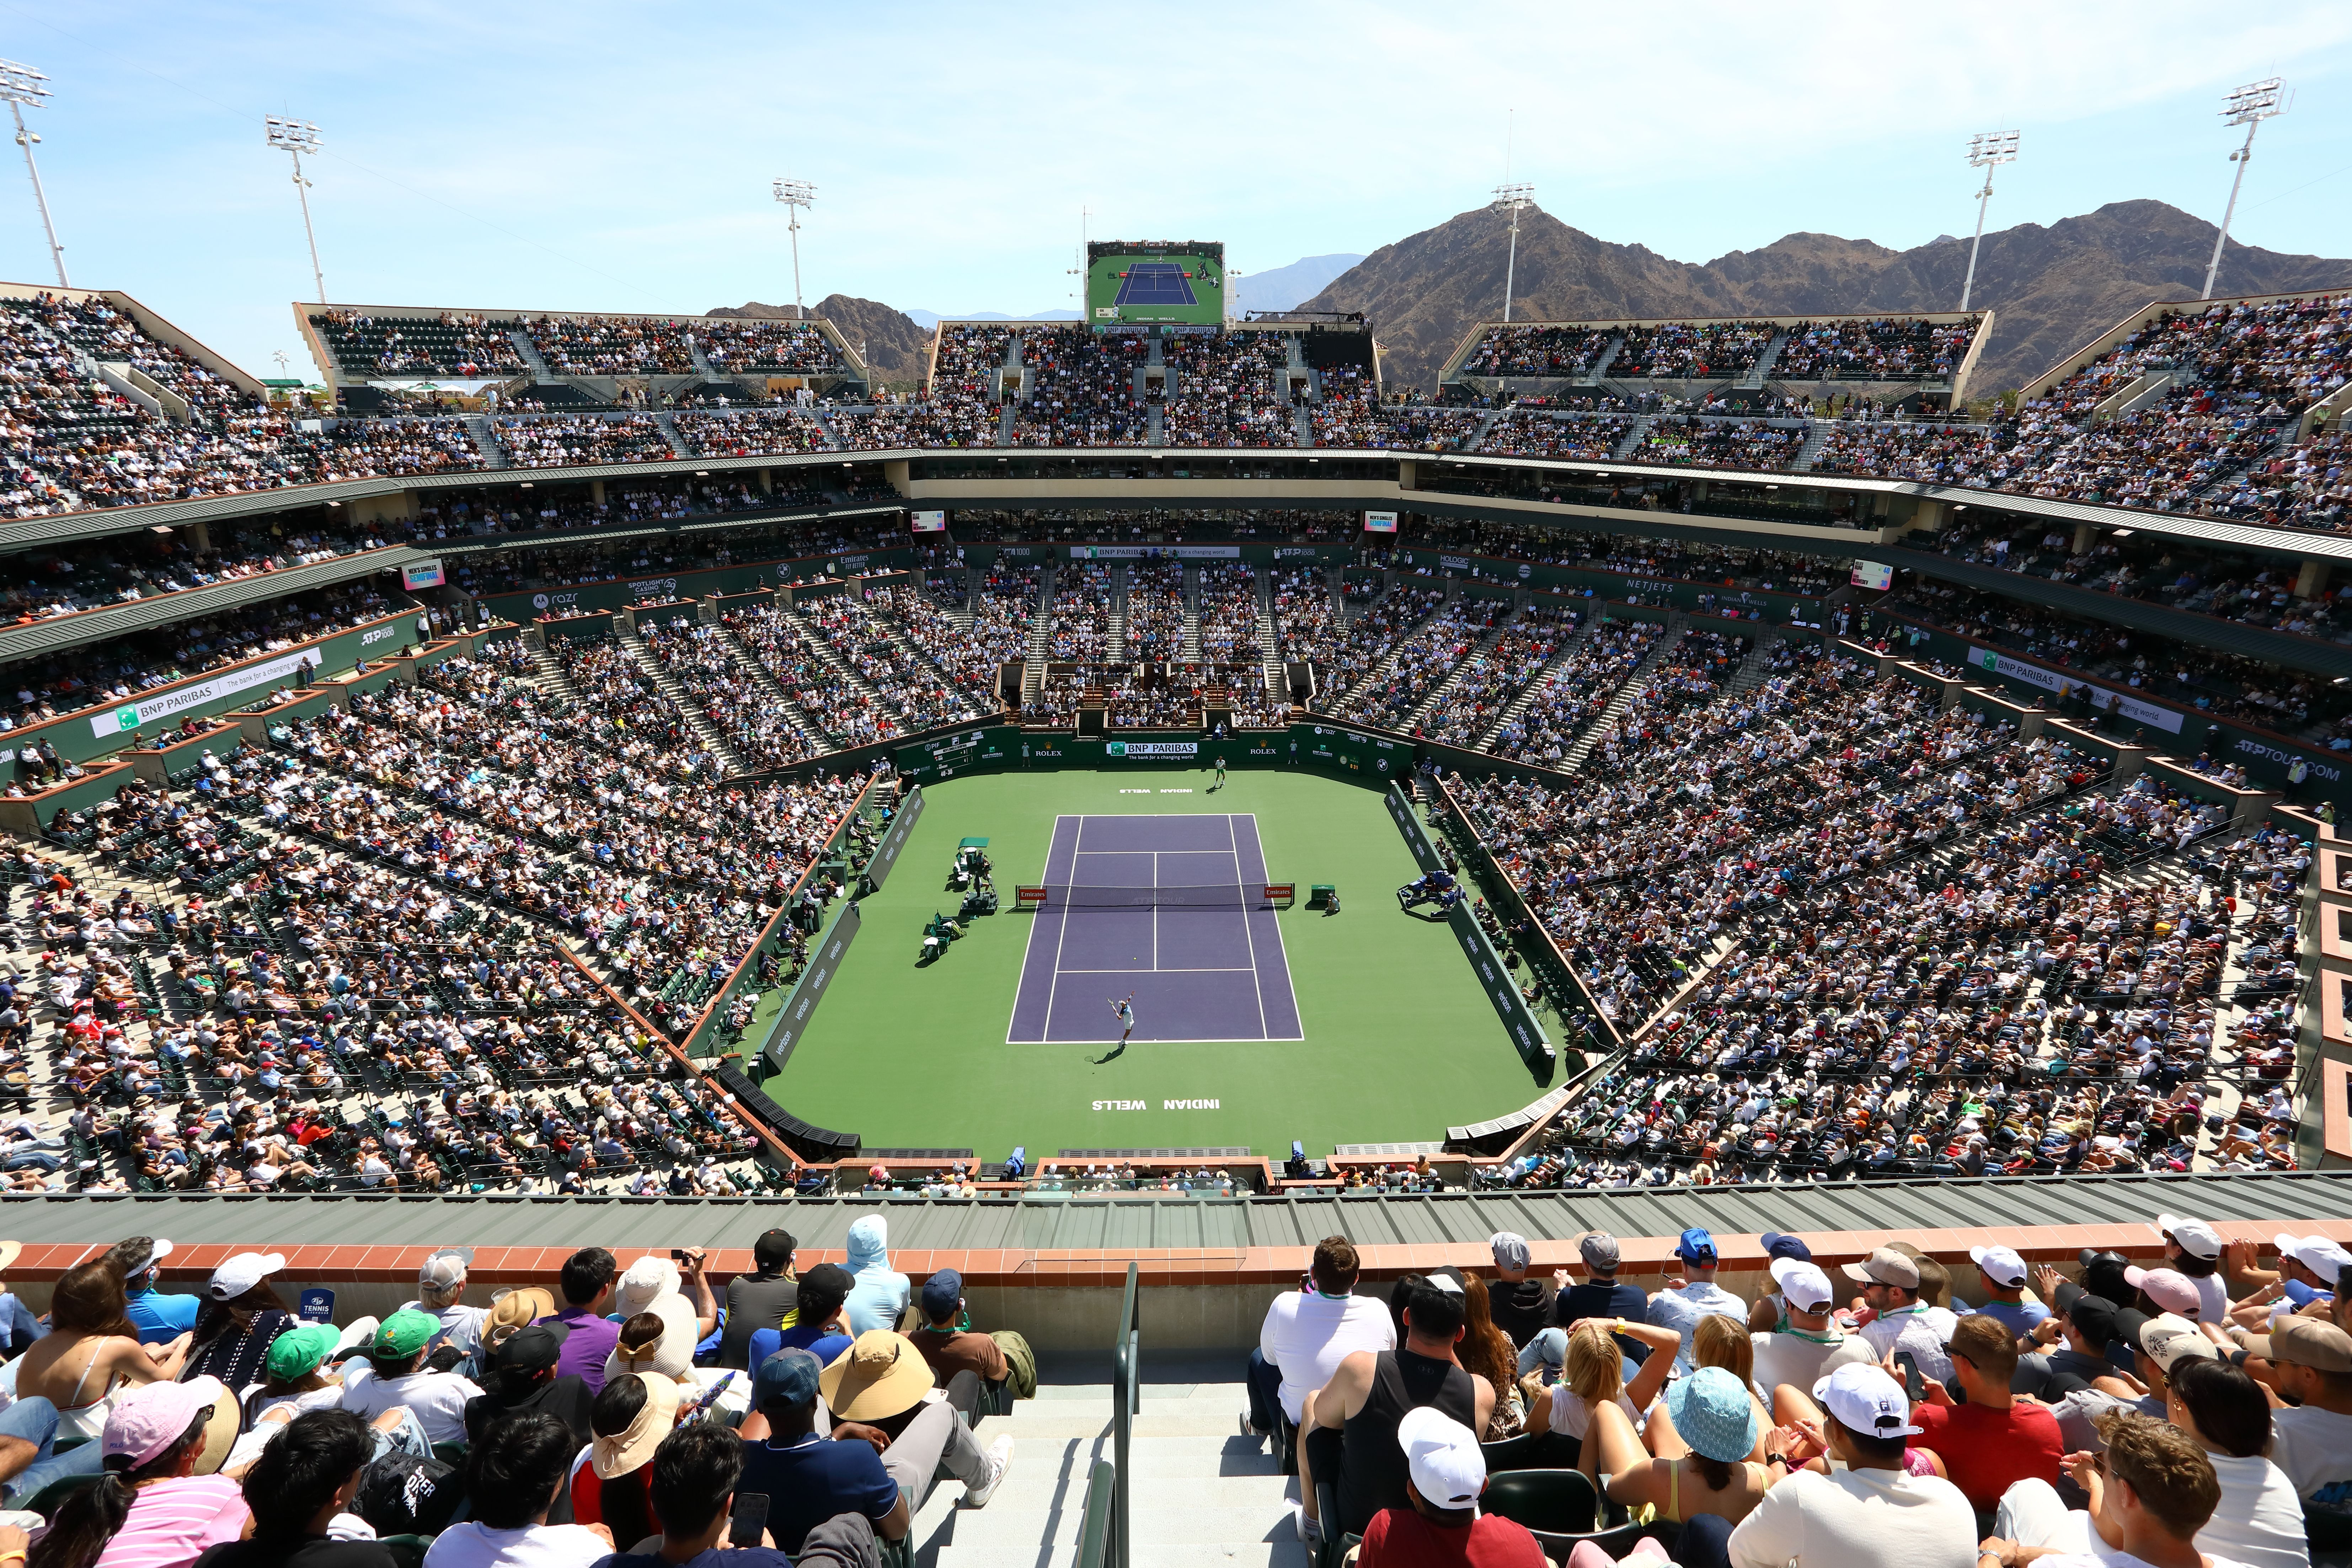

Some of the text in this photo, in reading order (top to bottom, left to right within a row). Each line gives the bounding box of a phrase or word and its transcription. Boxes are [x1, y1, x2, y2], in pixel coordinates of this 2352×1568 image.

[840, 555, 868, 564] Emirates
[1440, 555, 1469, 564] HOLOGIC
[409, 571, 439, 583] SEMIFINAL
[628, 579, 664, 588] SPOTLIGHT
[1627, 579, 1673, 593] NETJETS
[552, 593, 578, 604] razr
[360, 630, 381, 646] ATP
[381, 628, 394, 639] 1000
[227, 680, 239, 688] The
[239, 675, 253, 685] bank
[253, 672, 262, 681] for
[267, 664, 291, 676] changing
[291, 658, 304, 667] worl
[1998, 660, 2053, 685] BNP PARIBAS
[140, 686, 212, 717] BNP PARIBAS
[2095, 693, 2105, 703] for
[2139, 708, 2159, 721] world
[905, 814, 913, 826] verizon
[895, 829, 904, 843] verizon
[1406, 824, 1415, 839] verizon
[885, 847, 894, 861] verizon
[1416, 842, 1425, 857] verizon
[1156, 896, 1185, 905] TOUR
[829, 940, 842, 960] verizon
[1466, 934, 1479, 955] verizon
[812, 968, 826, 990] verizon
[1481, 960, 1494, 983] verizon
[1497, 990, 1512, 1013] verizon
[795, 998, 810, 1021] verizon
[776, 1031, 792, 1055] verizon
[1516, 1023, 1531, 1049] verizon
[1092, 1099, 1220, 1111] INDIAN WELLS
